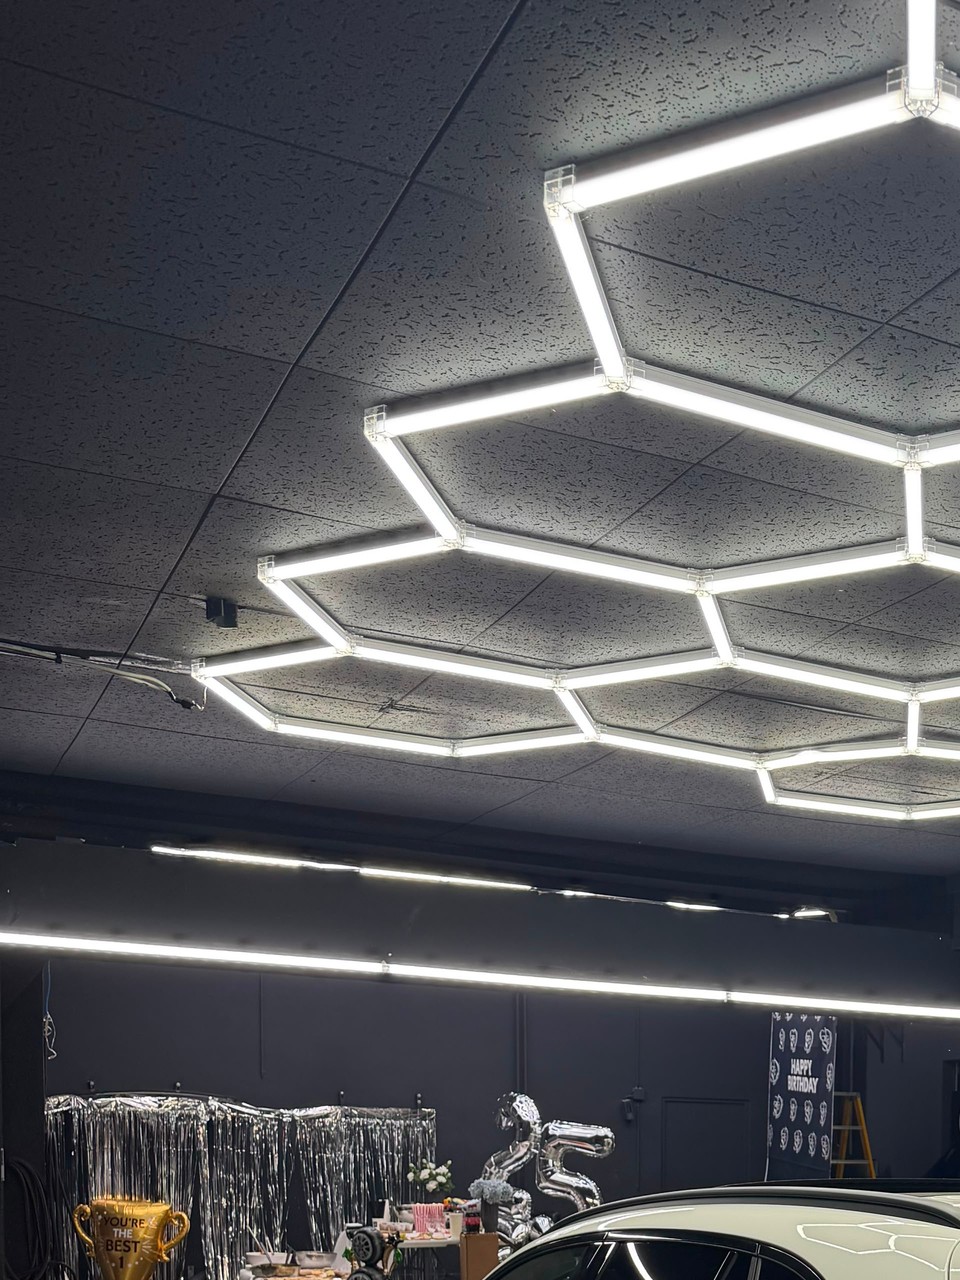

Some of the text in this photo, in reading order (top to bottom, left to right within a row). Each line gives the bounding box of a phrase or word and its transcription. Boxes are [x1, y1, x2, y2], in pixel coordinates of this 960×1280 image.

[790, 1058, 812, 1075] HAPPY
[787, 1075, 819, 1094] BIRTHDAY
[103, 1216, 146, 1229] YOU'RE
[112, 1228, 133, 1239] THE
[105, 1240, 140, 1253] BEST
